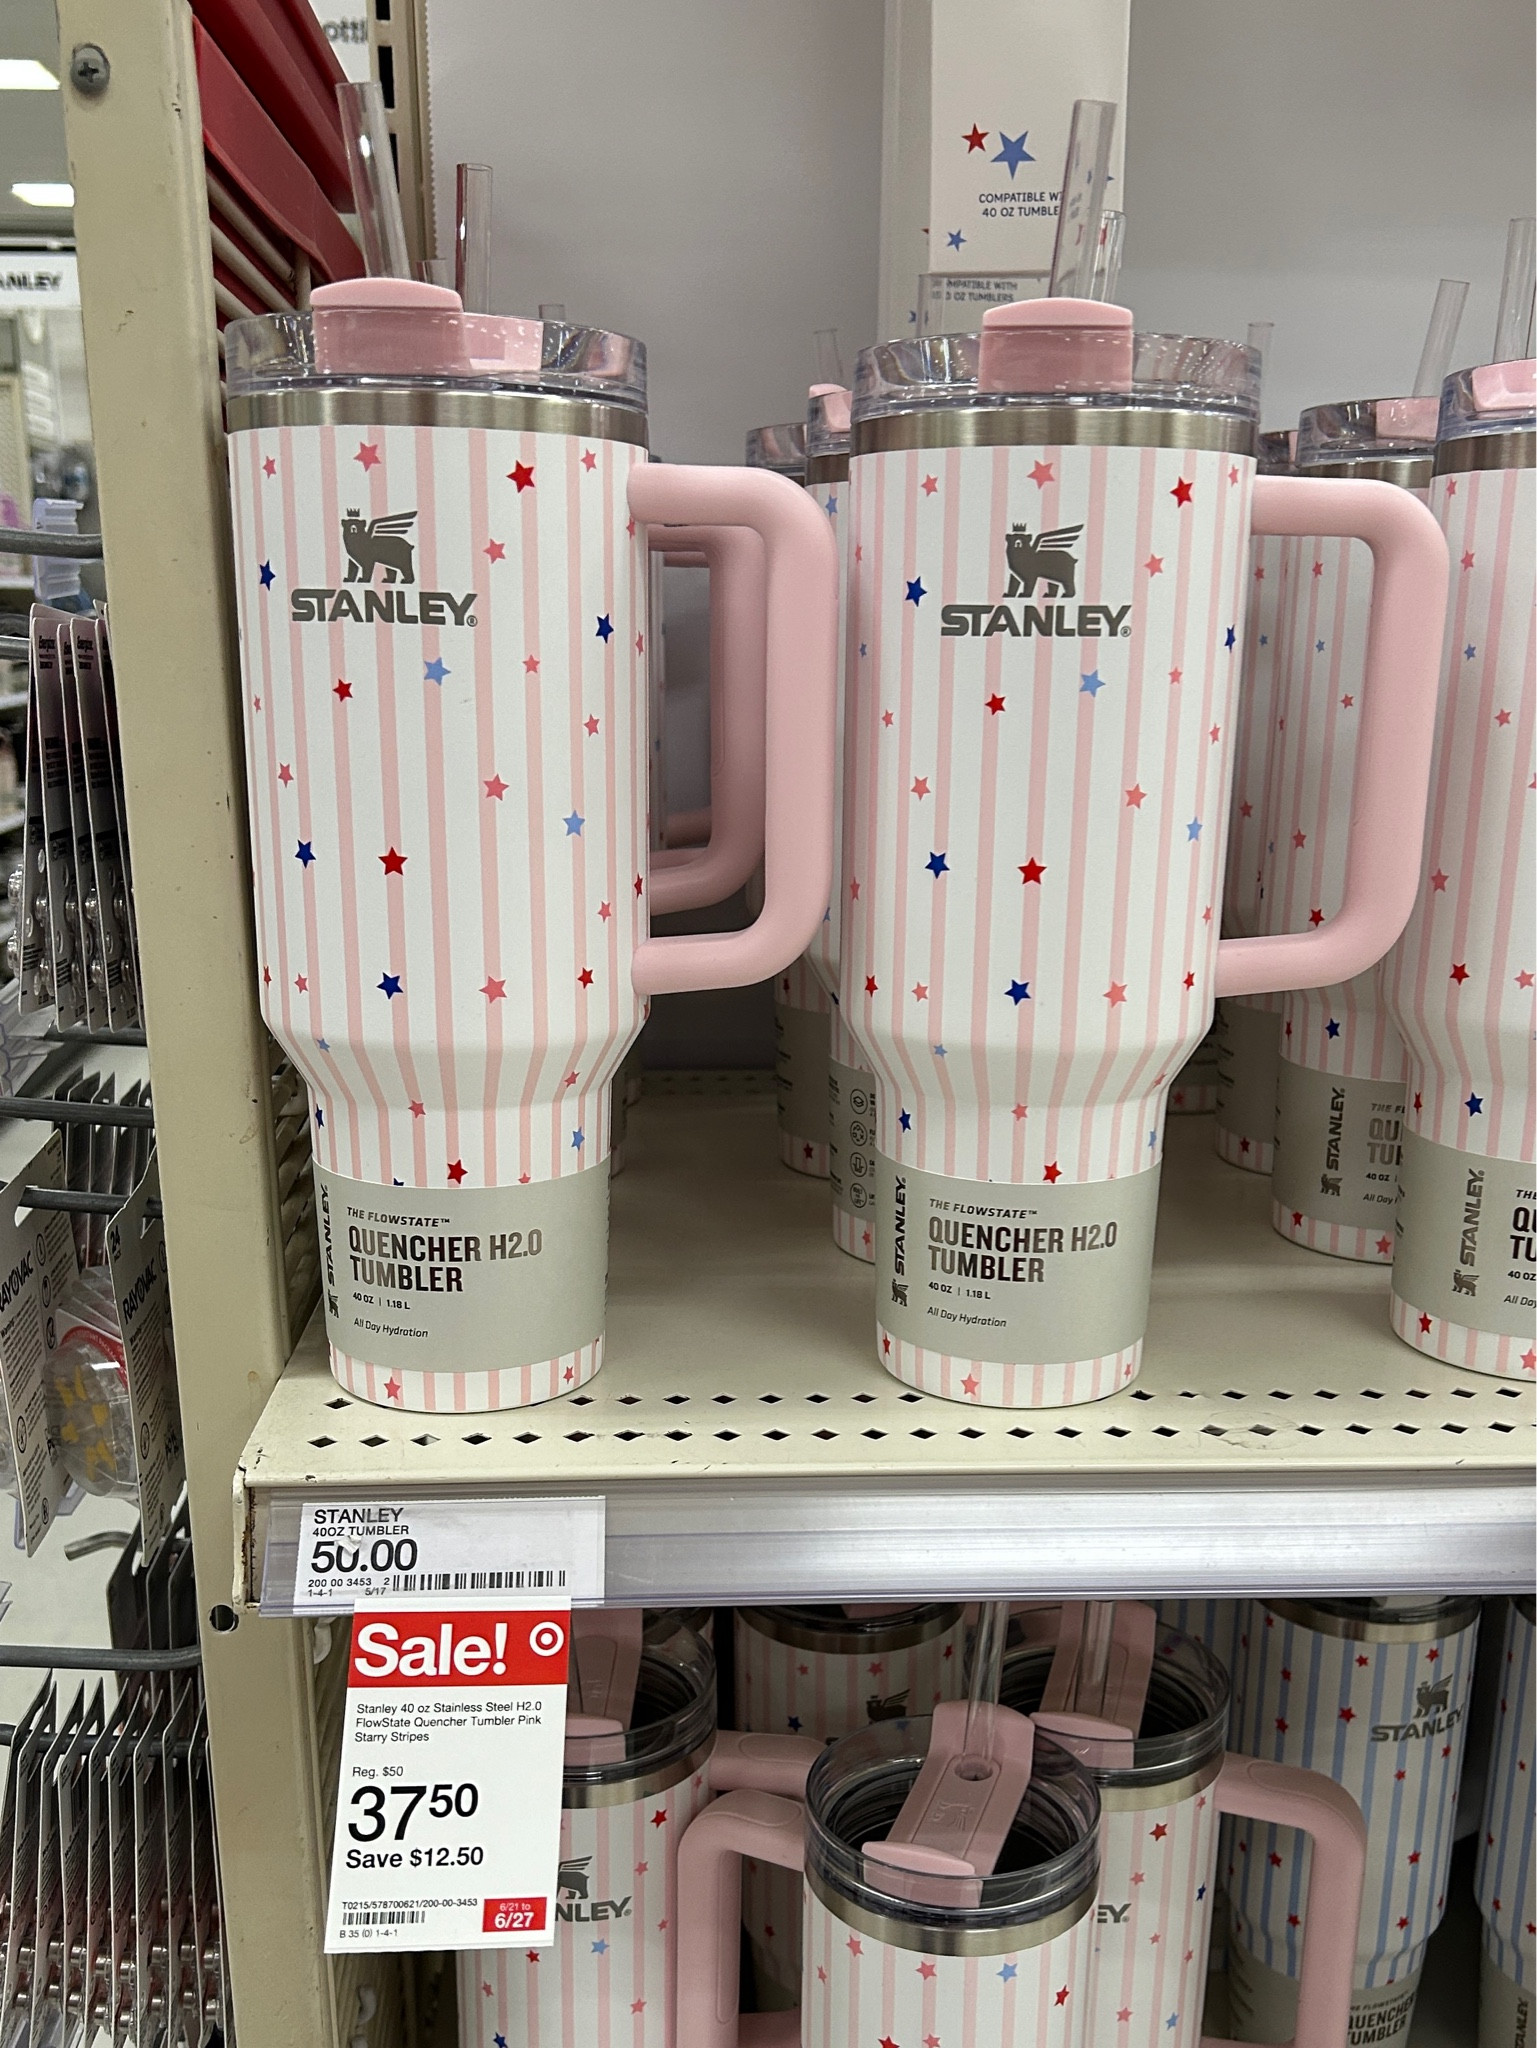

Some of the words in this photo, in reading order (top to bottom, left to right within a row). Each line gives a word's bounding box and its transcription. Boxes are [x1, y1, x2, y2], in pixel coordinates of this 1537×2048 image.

[979, 191, 1045, 204] COMPATIBLE
[982, 208, 997, 218] 40
[1000, 207, 1015, 217] OZ
[1371, 1103, 1392, 1113] THE
[1366, 1172, 1377, 1180] 40
[1378, 1173, 1390, 1182] OZ
[929, 1199, 950, 1210] THE
[1363, 1193, 1375, 1203] All
[1376, 1195, 1393, 1205] Day
[347, 1206, 365, 1219] THE
[929, 1216, 1064, 1254] QUENCHER
[1071, 1221, 1117, 1252] H2.0
[349, 1225, 481, 1262] QUENCHER
[490, 1229, 542, 1261] H2.0
[928, 1245, 1045, 1283] TUMBLER
[350, 1254, 464, 1292] TUMBLER
[1508, 1270, 1521, 1279] 40
[1522, 1272, 1536, 1281] OZ
[928, 1281, 939, 1290] 40
[940, 1284, 953, 1293] OZ
[966, 1289, 983, 1298] 1.18
[985, 1291, 991, 1299] L
[353, 1292, 362, 1301] 40
[363, 1295, 374, 1304] OZ
[387, 1299, 402, 1309] 1.18
[405, 1301, 410, 1310] L
[1504, 1294, 1519, 1304] All
[927, 1306, 940, 1316] All
[940, 1309, 958, 1322] Day
[959, 1313, 1007, 1327] Hydration
[354, 1317, 364, 1327] All
[365, 1320, 381, 1333] Day
[383, 1324, 428, 1338] Hydration
[314, 1507, 404, 1524] STANLEY
[313, 1526, 345, 1537] 40OZ
[349, 1525, 409, 1536] TUMBLER
[311, 1538, 418, 1573] 50.00
[308, 1579, 327, 1588] 200
[330, 1578, 343, 1587] 00
[346, 1577, 372, 1587] 3453
[383, 1577, 390, 1586] 2
[308, 1588, 333, 1597] 1-4-1
[365, 1587, 386, 1596] 5/17
[355, 1622, 507, 1678] Sale!
[356, 1703, 397, 1716] Stanley
[400, 1703, 415, 1713] 40
[417, 1704, 430, 1713] oz
[433, 1702, 482, 1713] Stainless
[485, 1701, 513, 1712] Steel
[516, 1701, 542, 1711] H2.0
[355, 1717, 411, 1728] FlowState
[414, 1717, 467, 1727] Quencher
[471, 1716, 515, 1726] Tumbler
[517, 1715, 542, 1725] Pink
[354, 1732, 387, 1744] Starry
[390, 1731, 430, 1743] Stripes
[352, 1766, 379, 1778] Reg.
[382, 1765, 404, 1777] $50
[346, 1849, 402, 1868] Save
[409, 1847, 484, 1868] $12.50
[499, 1902, 519, 1911] 6/21
[521, 1902, 531, 1911] to
[494, 1911, 534, 1929] 6/27
[340, 1930, 346, 1938] B
[348, 1929, 359, 1938] 35
[376, 1929, 398, 1937] 1-4-1
